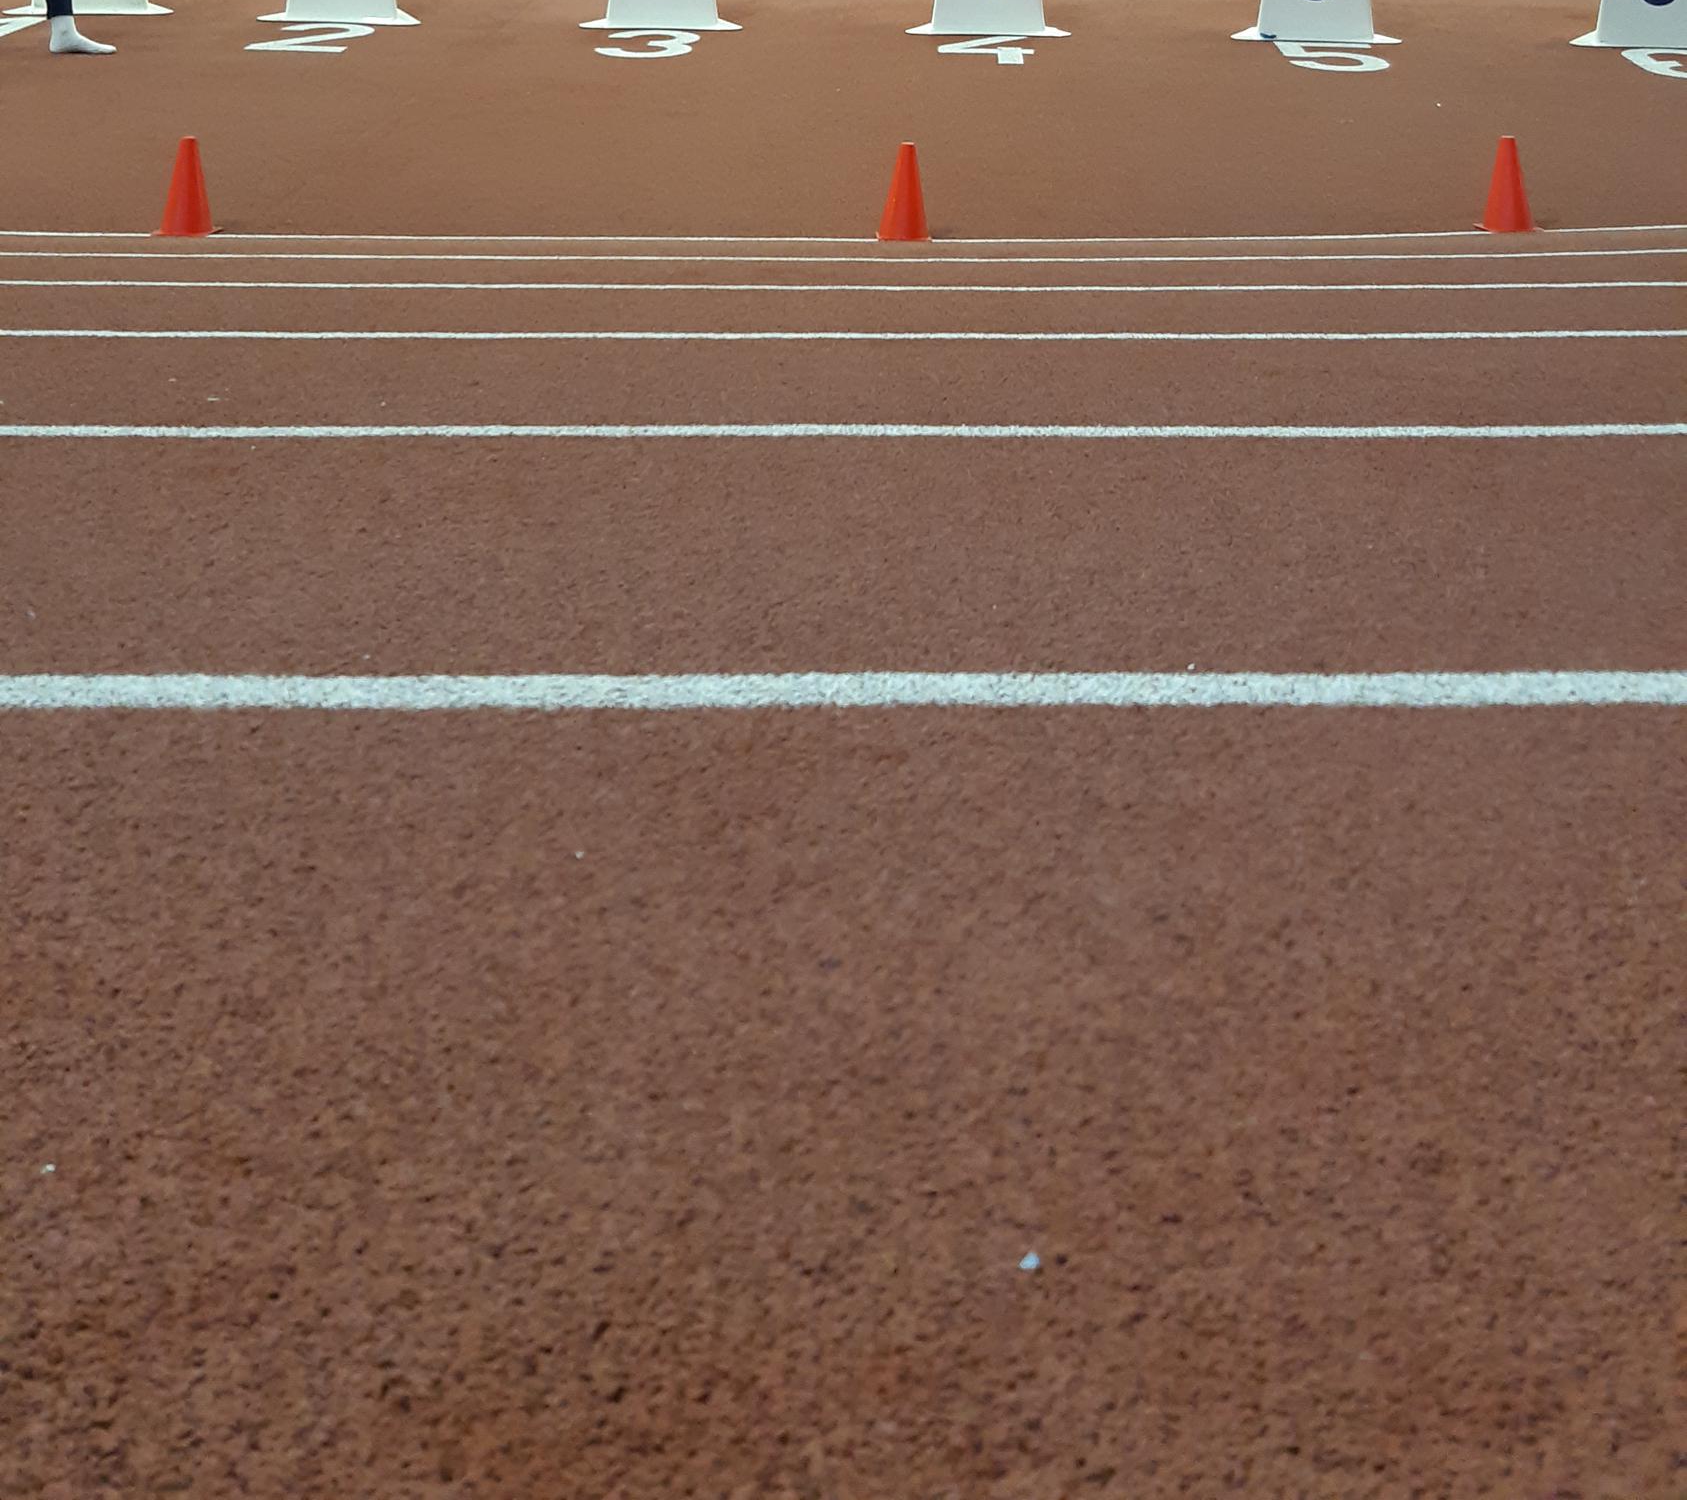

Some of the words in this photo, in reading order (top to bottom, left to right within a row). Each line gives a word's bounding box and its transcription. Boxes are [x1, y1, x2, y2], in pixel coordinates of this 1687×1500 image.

[243, 23, 376, 53] 2
[594, 29, 701, 58] 3
[937, 36, 1035, 65] 4
[1273, 40, 1391, 72] 5
